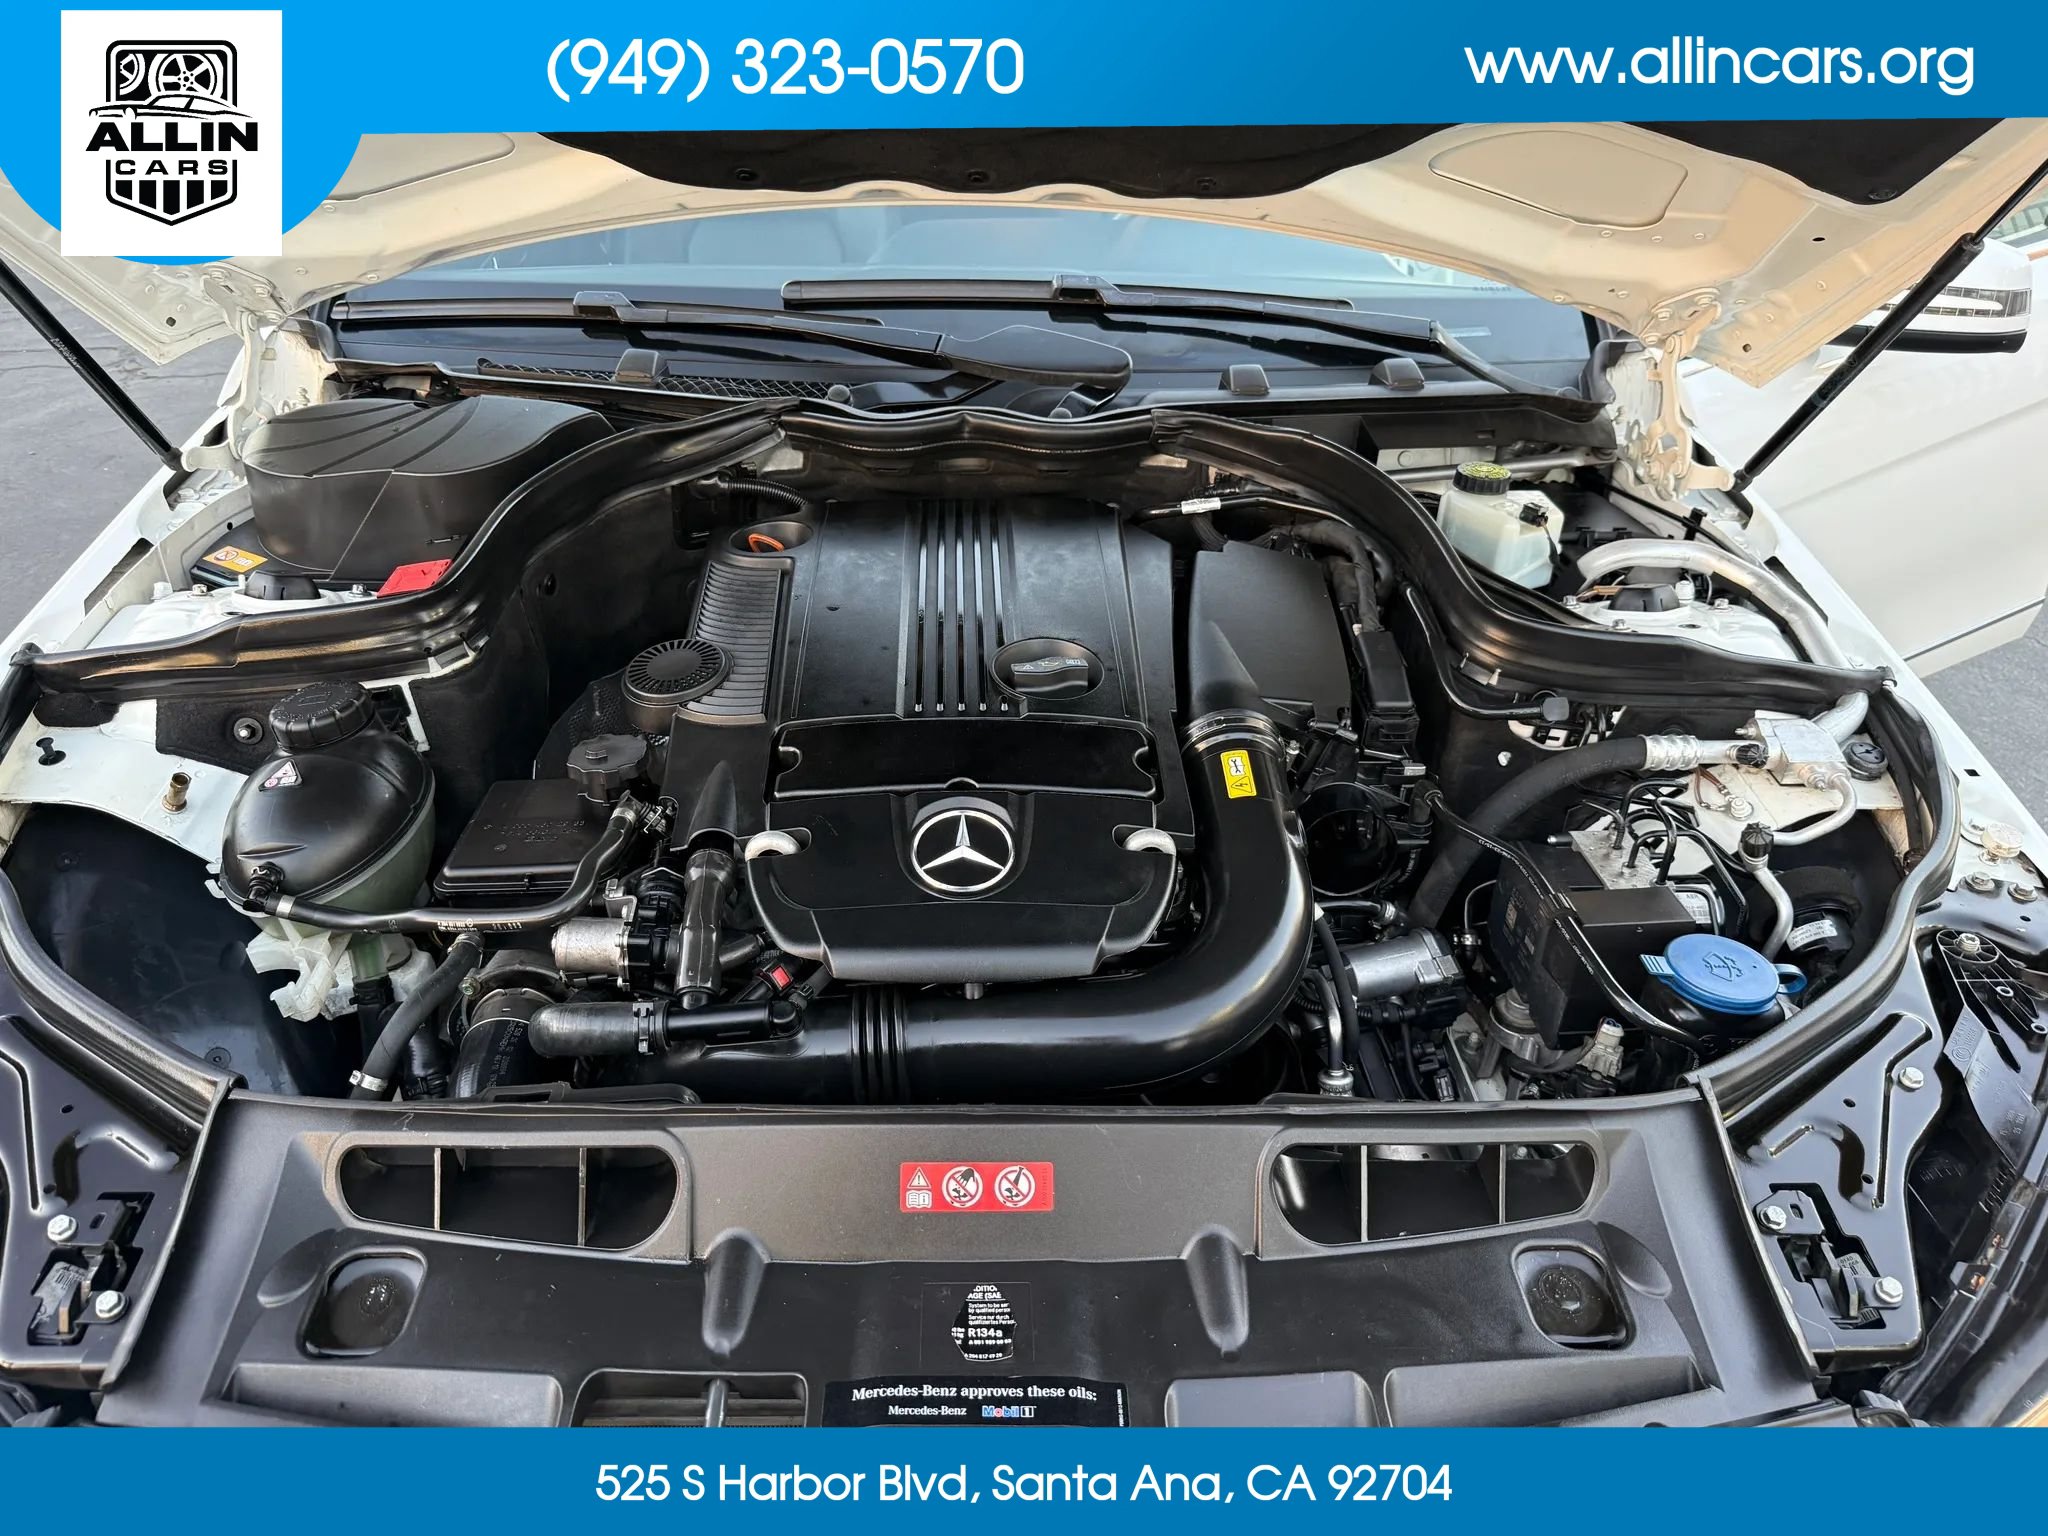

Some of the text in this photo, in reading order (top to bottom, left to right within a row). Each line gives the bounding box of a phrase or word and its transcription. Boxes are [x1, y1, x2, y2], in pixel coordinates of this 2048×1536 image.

[967, 1328, 1003, 1338] R134a
[852, 1384, 1098, 1402] Mercedes-Benz approves these oils:
[888, 1405, 968, 1416] Mercedes-Benz
[981, 1405, 1020, 1418] Mobil
